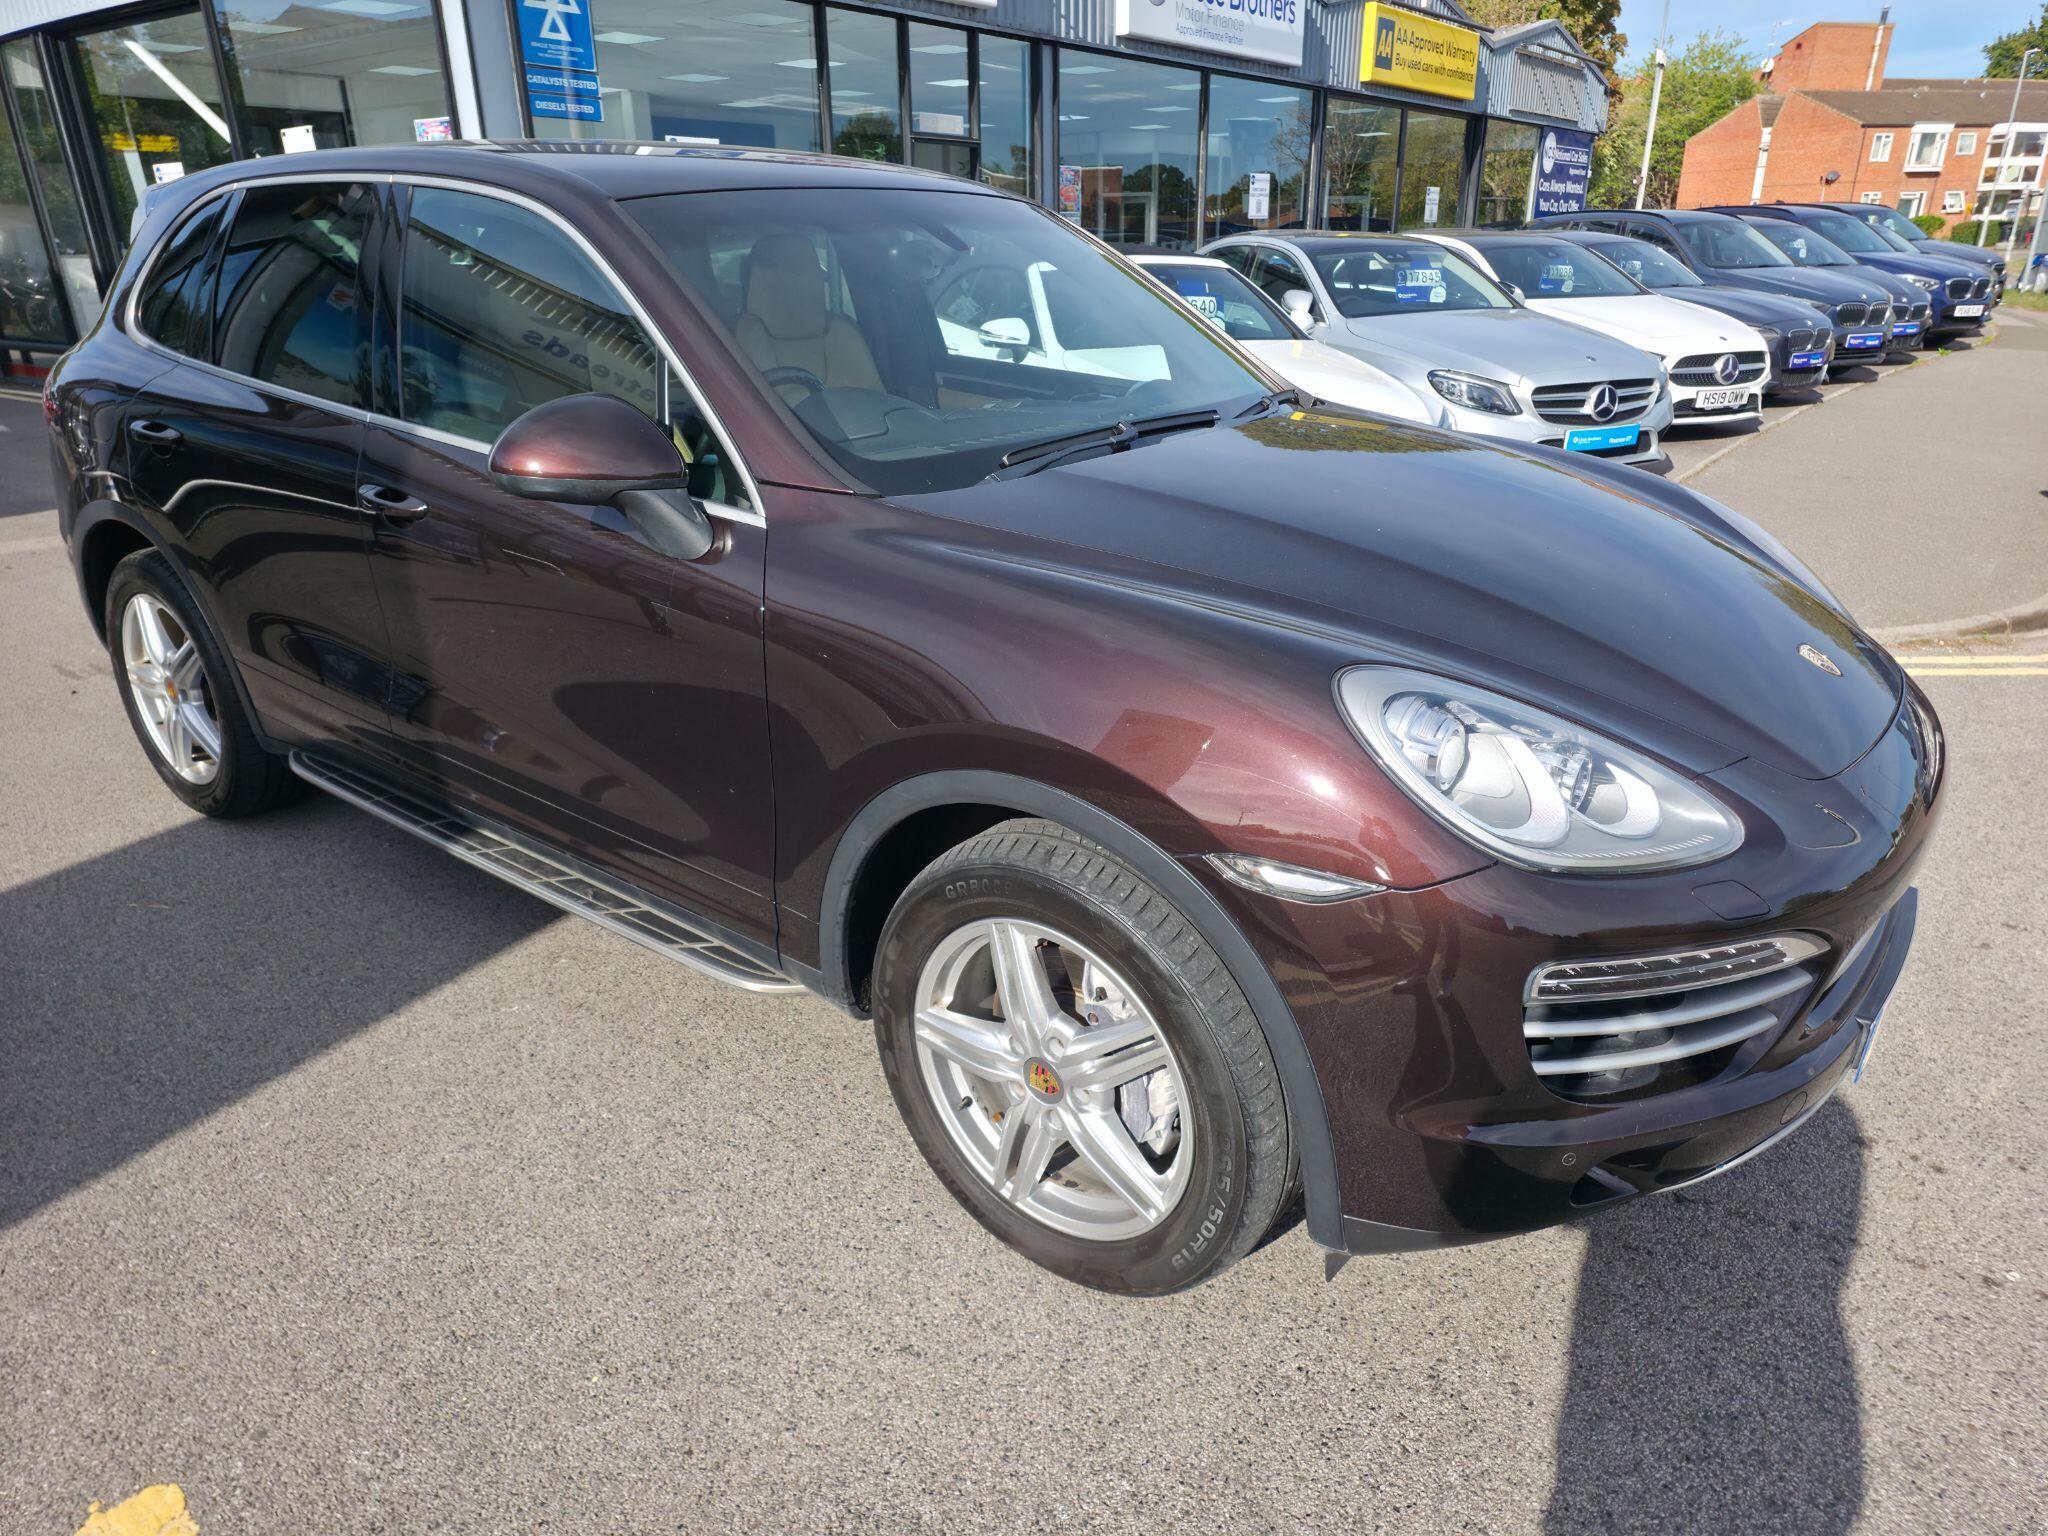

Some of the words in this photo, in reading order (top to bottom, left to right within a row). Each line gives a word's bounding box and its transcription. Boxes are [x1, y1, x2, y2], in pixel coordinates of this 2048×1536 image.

[1175, 1, 1204, 24] Motor
[1207, 8, 1246, 32] Finance
[1175, 22, 1201, 37] Approved
[1203, 27, 1223, 42] Finance
[1376, 29, 1393, 59] AA
[1395, 27, 1408, 46] AA
[1409, 30, 1445, 55] Approved
[1445, 39, 1476, 67] Warranty
[1395, 53, 1406, 70] Buy
[1407, 57, 1421, 71] used
[1422, 62, 1433, 73] cars
[1434, 63, 1446, 77] with
[1446, 66, 1474, 82] confidence
[526, 74, 568, 87] CATALYSTS
[569, 79, 597, 90] TESTED
[535, 100, 566, 111] DIESELS
[567, 103, 594, 113] TESTED
[1539, 178, 1550, 192] Cars
[1550, 179, 1566, 195] Always
[1703, 391, 1727, 405] HS19
